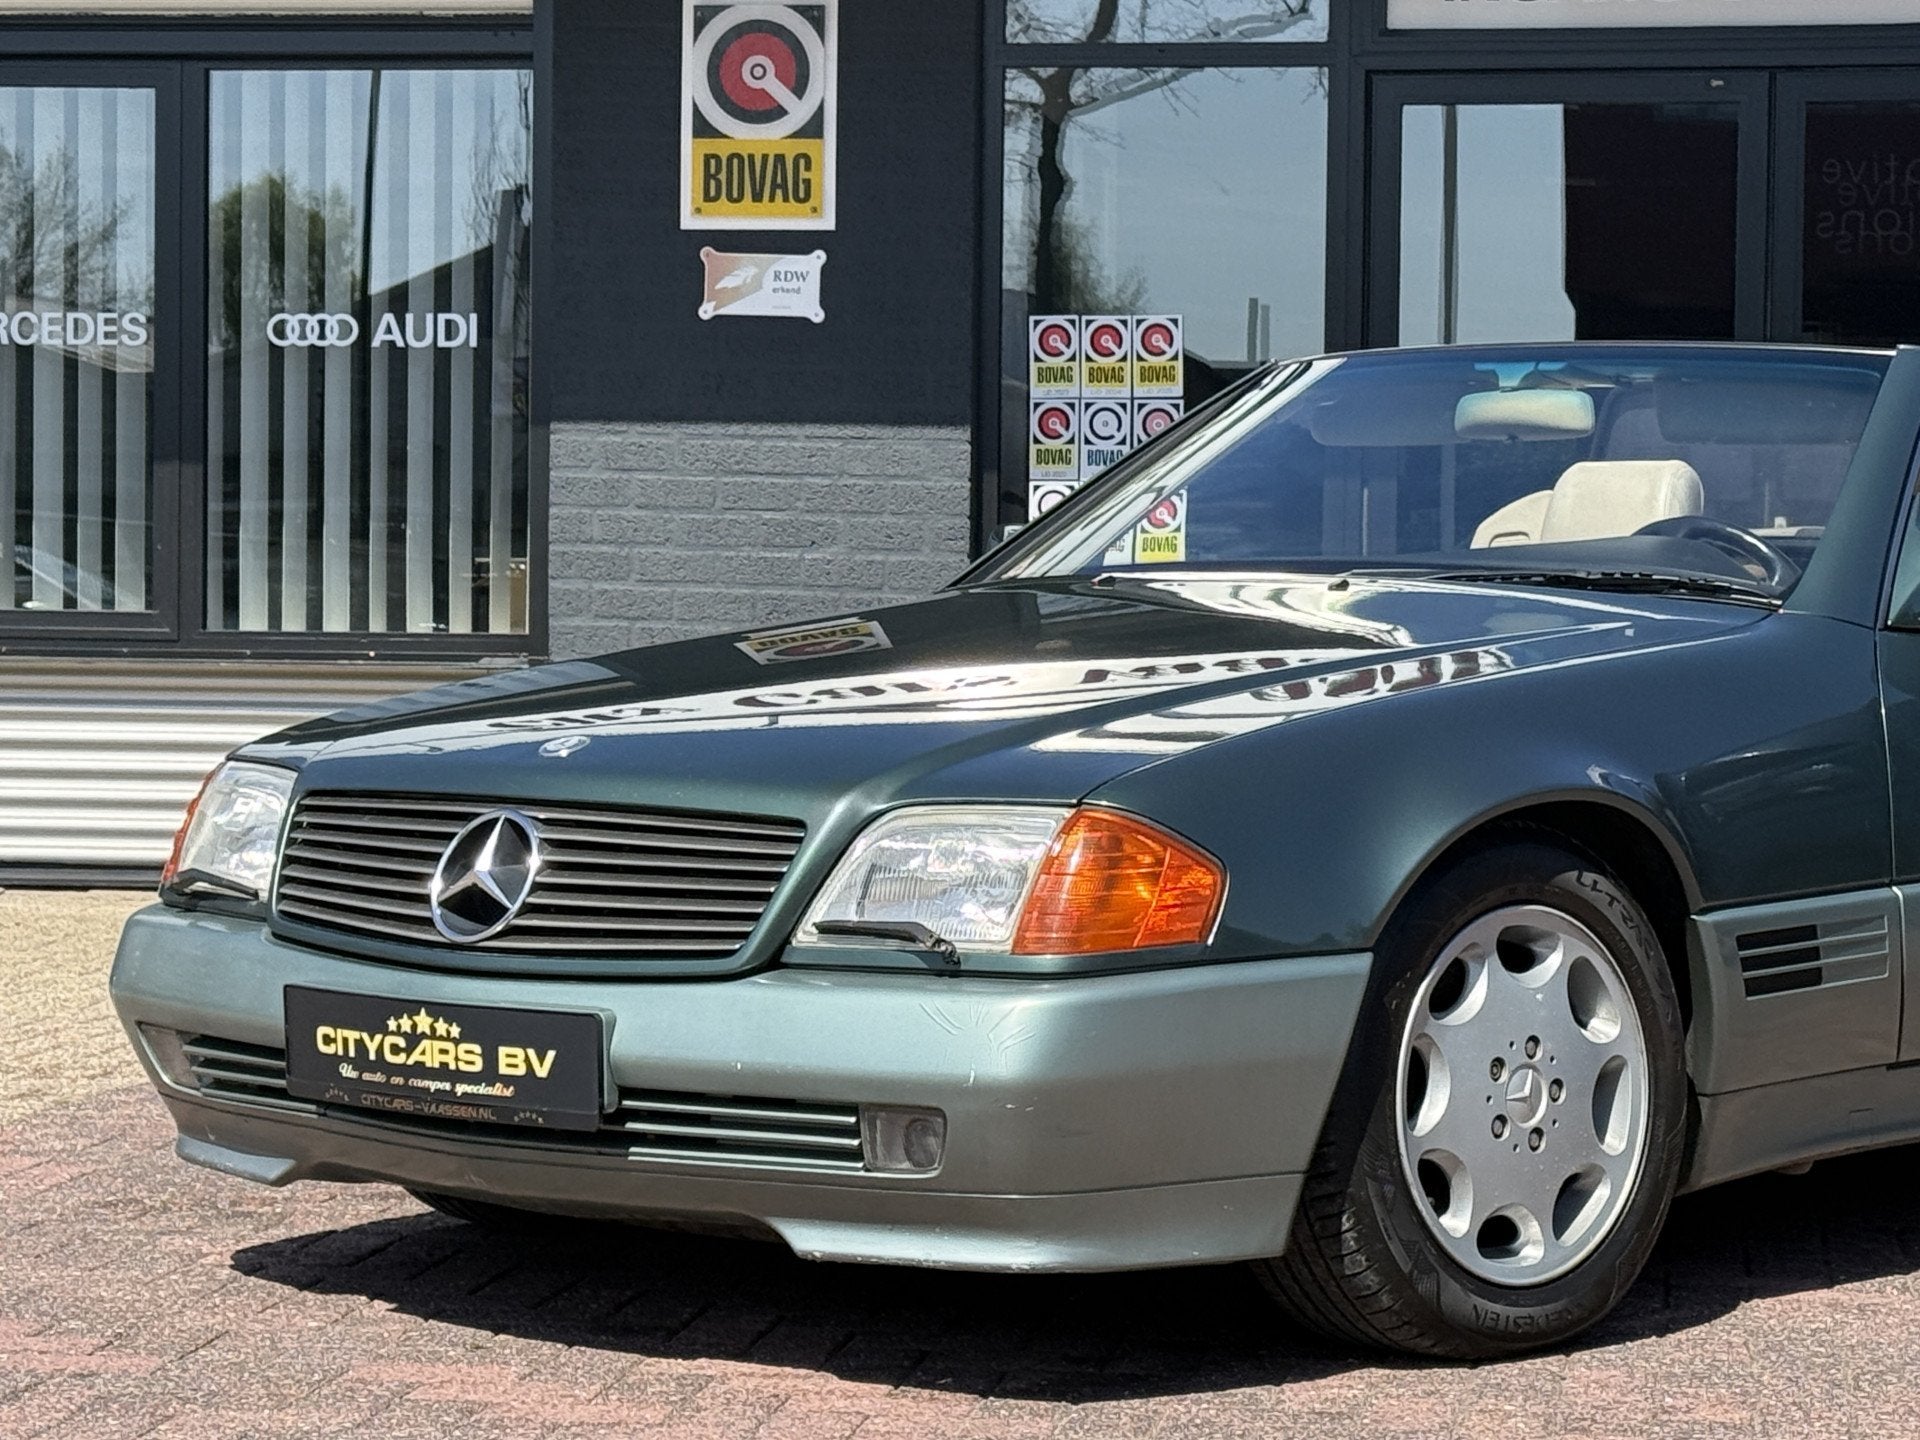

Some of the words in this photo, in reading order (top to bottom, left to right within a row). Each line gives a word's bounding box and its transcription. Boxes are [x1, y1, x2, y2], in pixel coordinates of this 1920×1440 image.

[702, 152, 813, 204] BOVAG
[772, 270, 810, 283] RDW
[371, 312, 478, 349] AUDI
[1037, 365, 1074, 384] BOVAG
[1088, 365, 1125, 384] BOVAG
[1139, 365, 1176, 383] BOVAG
[1036, 448, 1072, 465] BOVAG
[1142, 535, 1178, 553] BOVAG
[316, 1025, 484, 1073] CITYCARS
[498, 1045, 557, 1078] BV
[361, 1070, 387, 1084] auto
[390, 1075, 405, 1086] en
[454, 1081, 515, 1098] specialist
